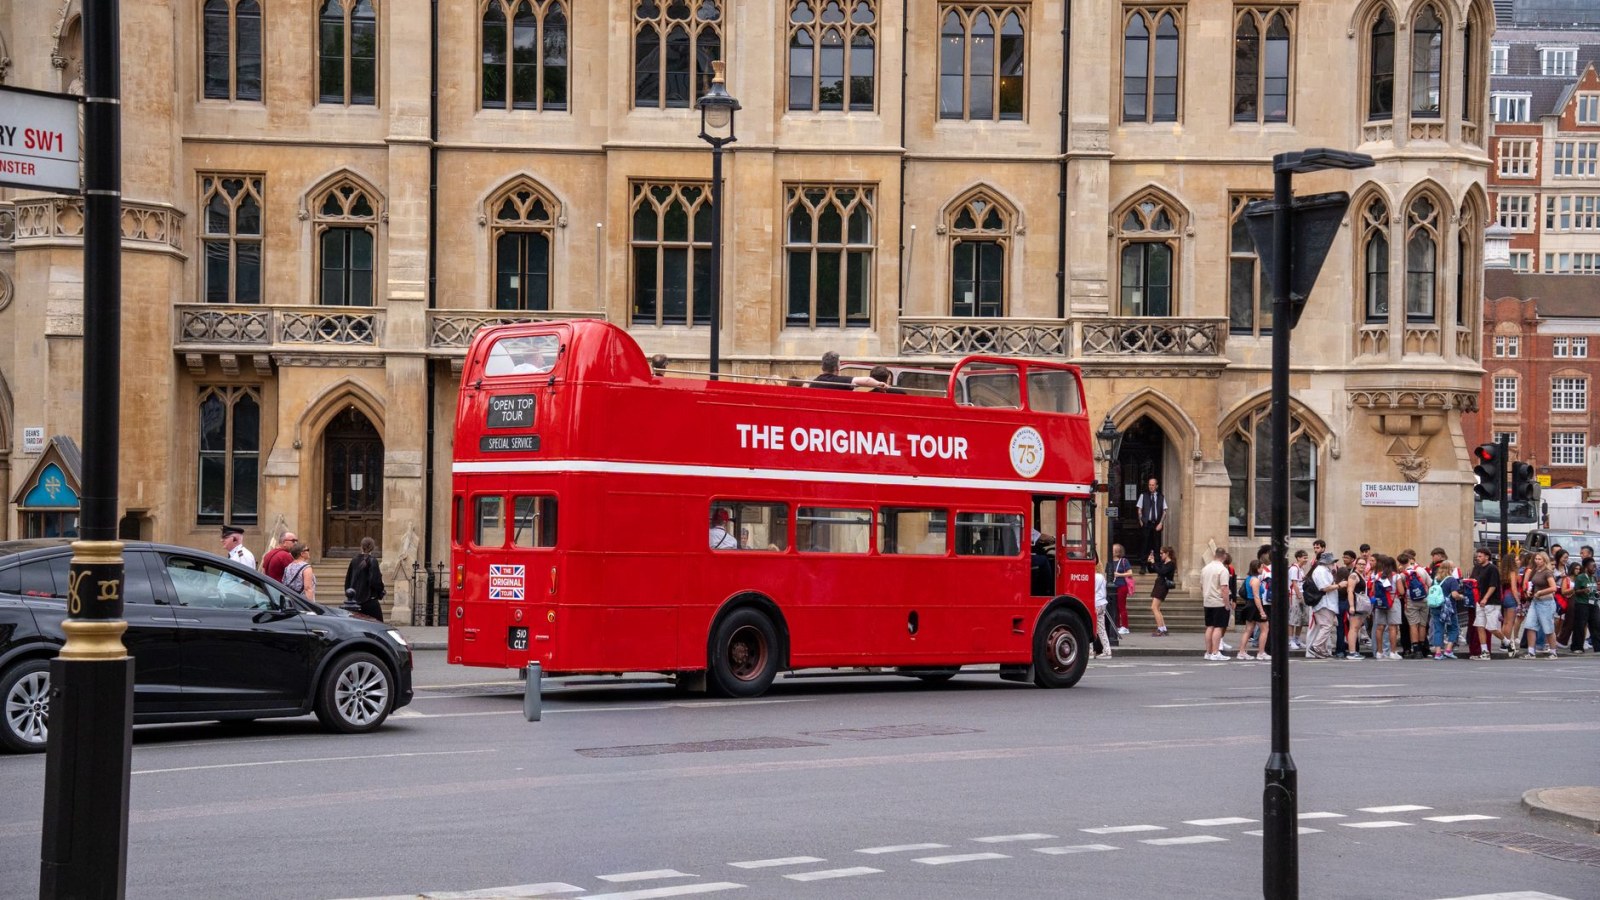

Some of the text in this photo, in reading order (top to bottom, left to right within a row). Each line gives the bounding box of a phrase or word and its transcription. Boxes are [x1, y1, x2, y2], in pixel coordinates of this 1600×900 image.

[24, 128, 62, 152] SW1
[494, 399, 533, 410] OPEN TOP
[502, 411, 522, 422] TOUR
[489, 437, 532, 448] SPECIAL SERVICE
[736, 424, 968, 460] THE ORIGINAL TOUR
[516, 630, 526, 638] 510
[514, 640, 526, 649] CLT
